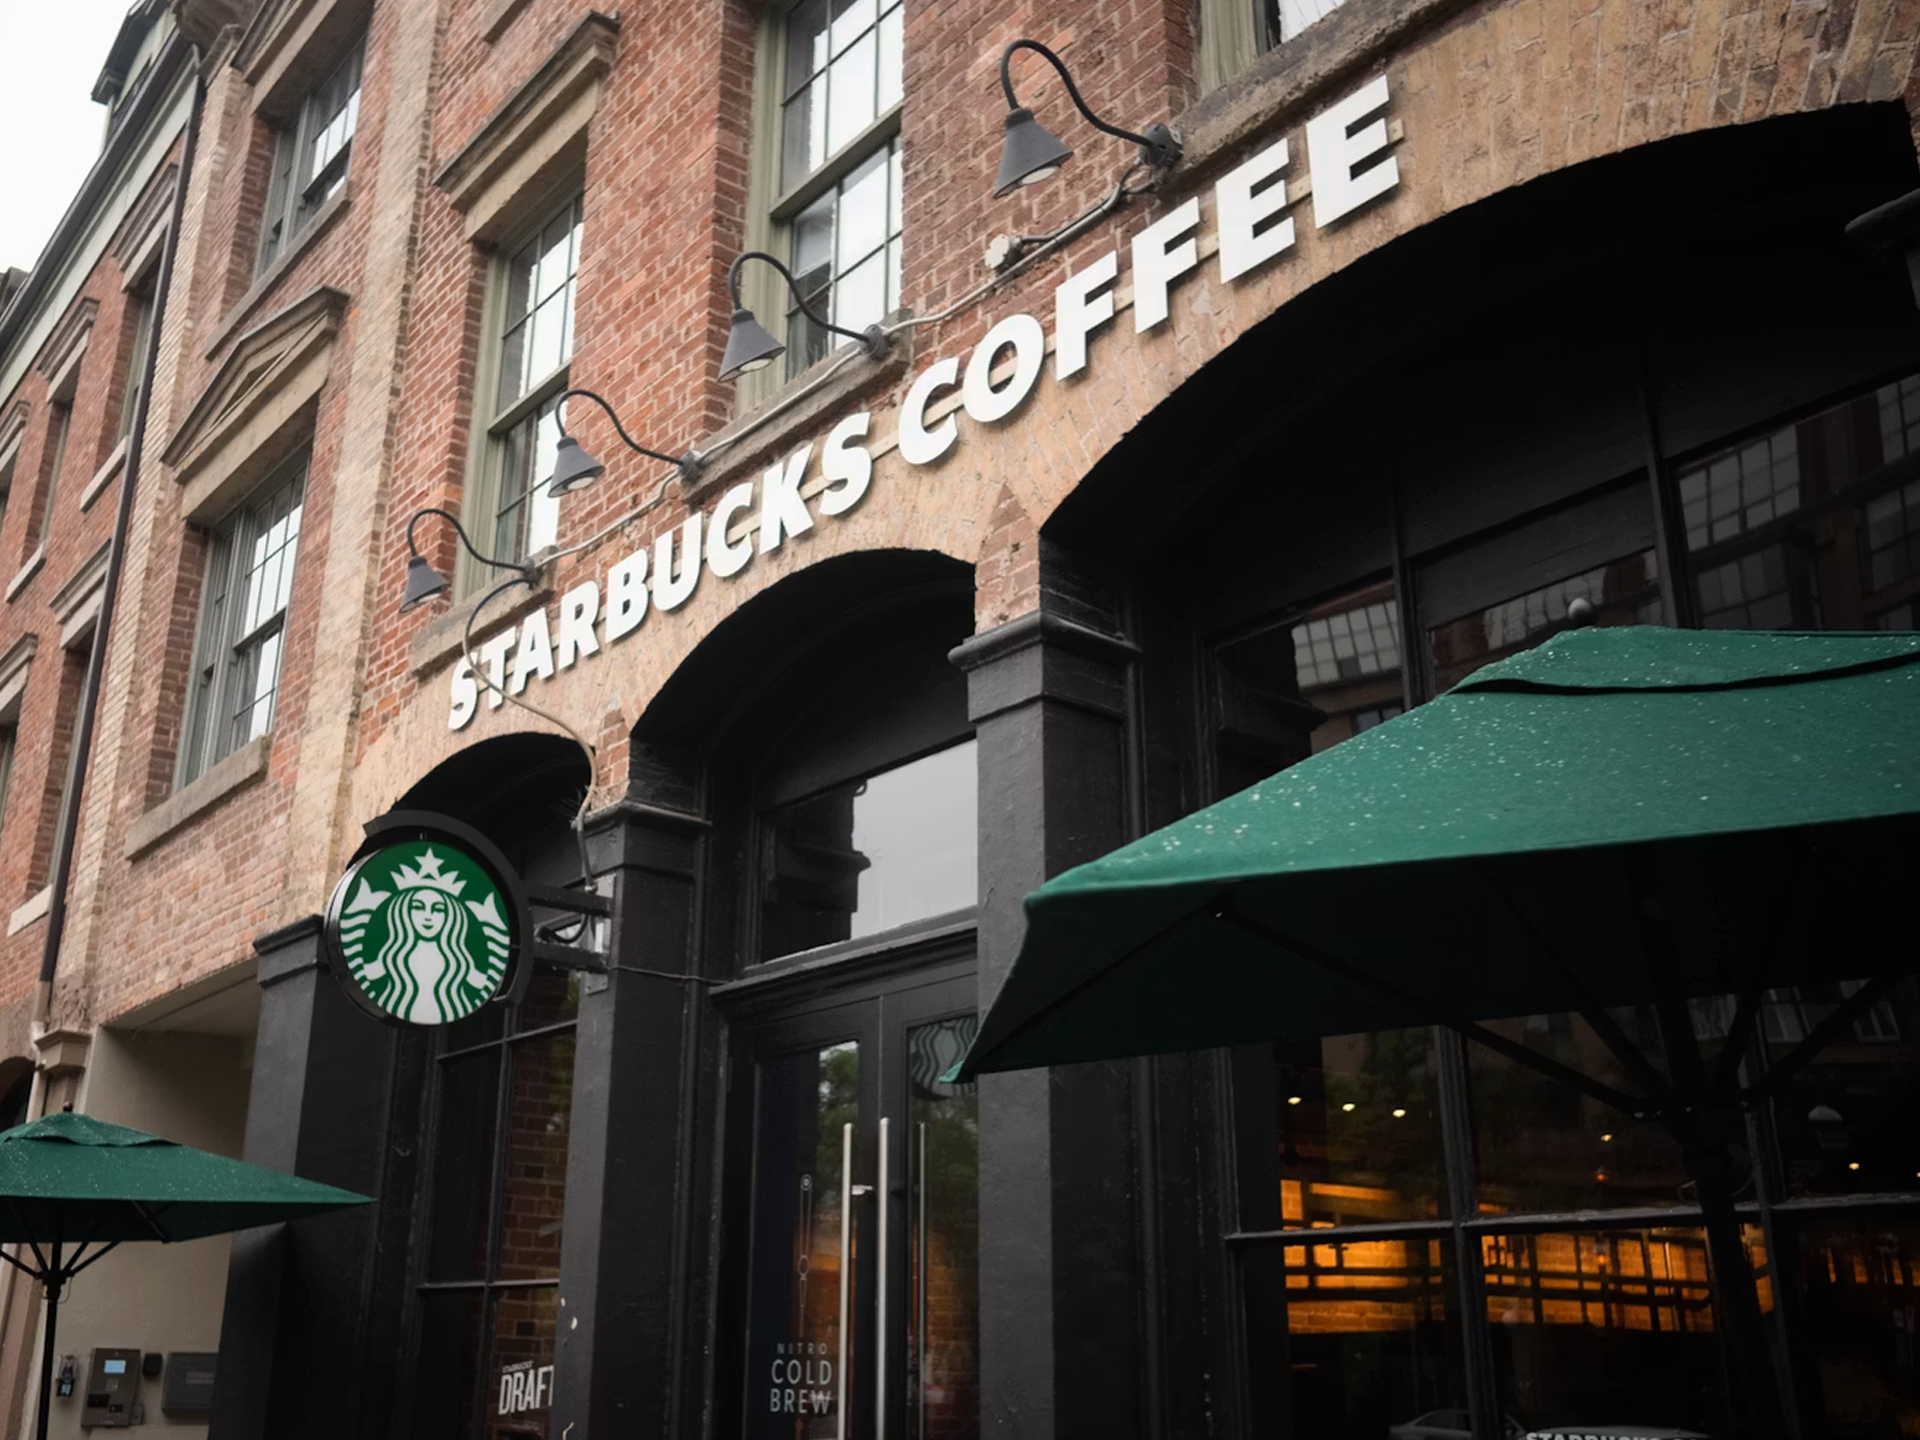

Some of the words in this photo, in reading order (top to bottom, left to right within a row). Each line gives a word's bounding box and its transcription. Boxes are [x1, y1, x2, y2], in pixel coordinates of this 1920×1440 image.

[447, 411, 874, 733] STARBUCKS
[897, 74, 1401, 467] COFFEE
[776, 1342, 828, 1356] NITRO
[771, 1359, 832, 1385] COLD
[770, 1388, 832, 1415] BREW
